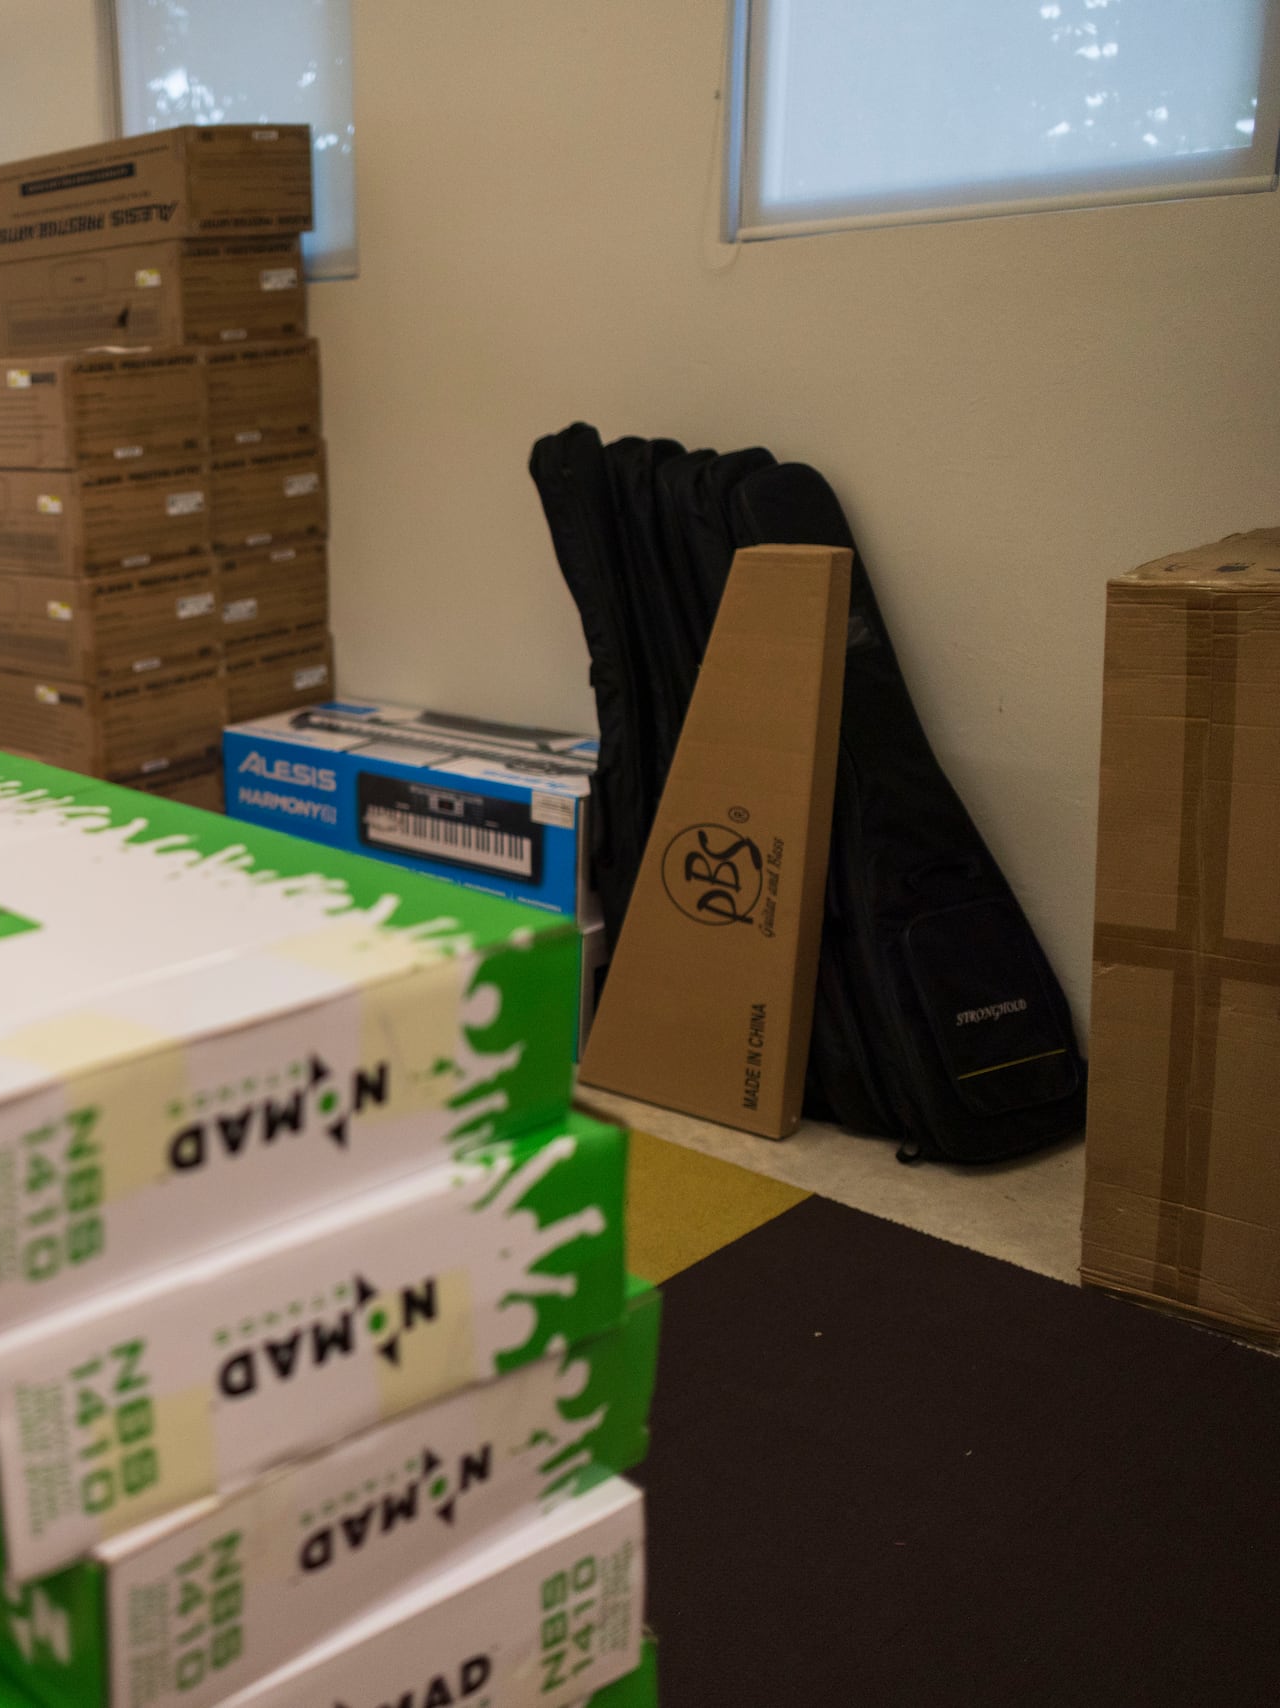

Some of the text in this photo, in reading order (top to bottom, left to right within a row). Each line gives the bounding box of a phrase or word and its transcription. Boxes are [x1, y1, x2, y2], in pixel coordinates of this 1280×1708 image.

[238, 751, 337, 792] ALESIS
[167, 1055, 389, 1173] NOMAD
[742, 1003, 768, 1111] MADE IN CHINA
[22, 1121, 60, 1283] 1410
[64, 1106, 105, 1267] NBS
[216, 1274, 438, 1400] NOMAD
[70, 1357, 115, 1515] 1410
[109, 1337, 159, 1497] NBS
[299, 1441, 493, 1574] NOMAD
[540, 1569, 569, 1692] NBS
